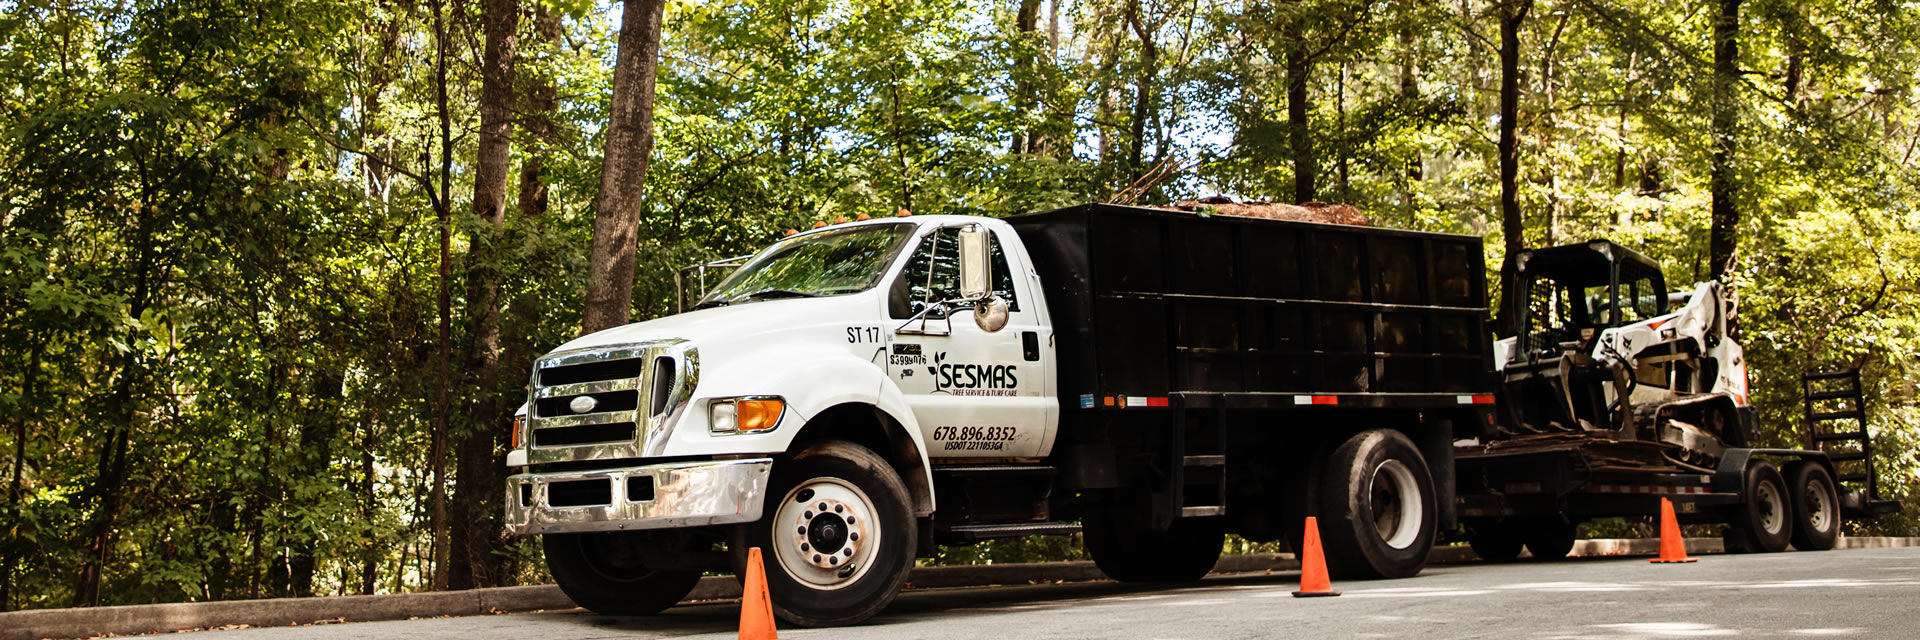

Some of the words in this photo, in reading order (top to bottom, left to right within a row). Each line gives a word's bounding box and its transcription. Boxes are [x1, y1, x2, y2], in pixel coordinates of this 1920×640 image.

[846, 326, 862, 344] ST
[865, 326, 879, 344] 17
[939, 363, 1018, 389] SESMAS
[1004, 389, 1018, 397] CARE
[933, 426, 1017, 441] 678.896.8352
[944, 441, 967, 451] USDOT
